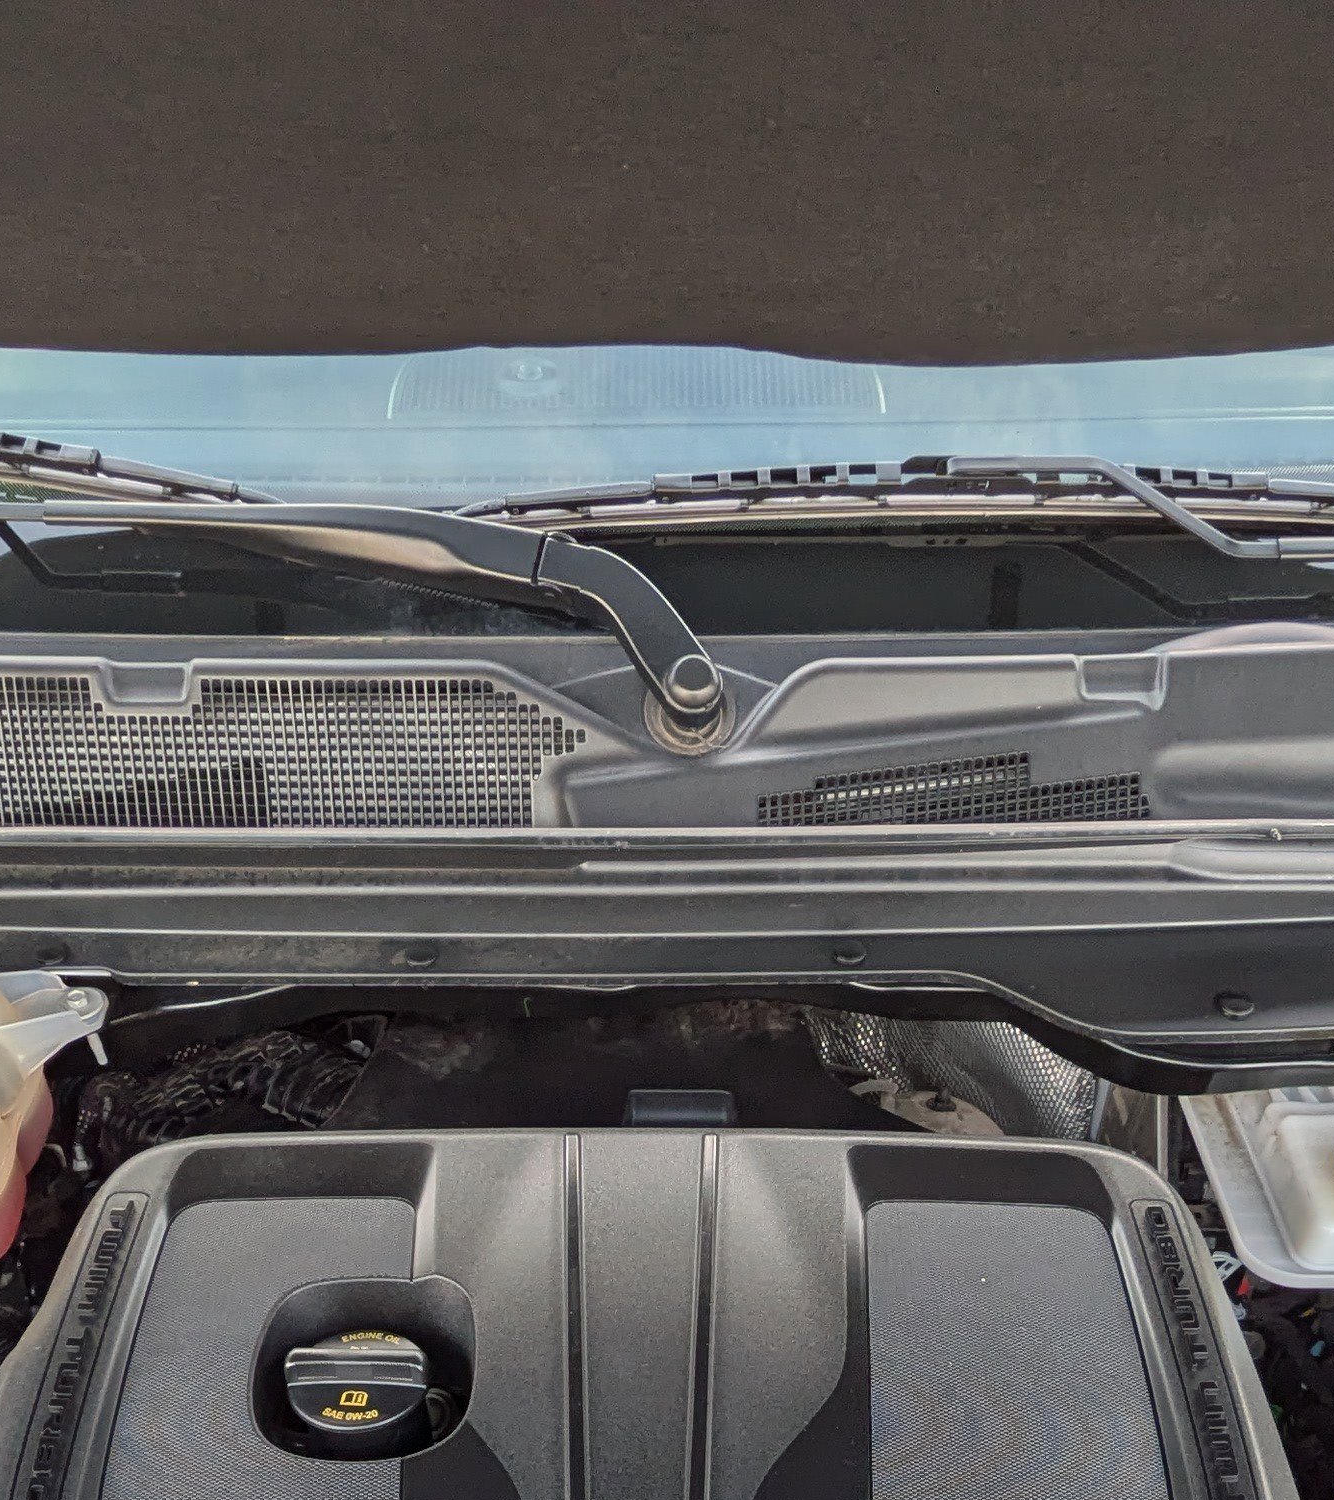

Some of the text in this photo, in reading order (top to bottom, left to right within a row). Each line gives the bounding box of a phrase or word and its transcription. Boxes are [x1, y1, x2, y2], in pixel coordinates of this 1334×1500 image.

[78, 1199, 135, 1326] TWIN
[1144, 1205, 1209, 1372] TURBO
[341, 1331, 401, 1345] ENGINE OIL
[322, 1406, 379, 1421] SAE 0W-20
